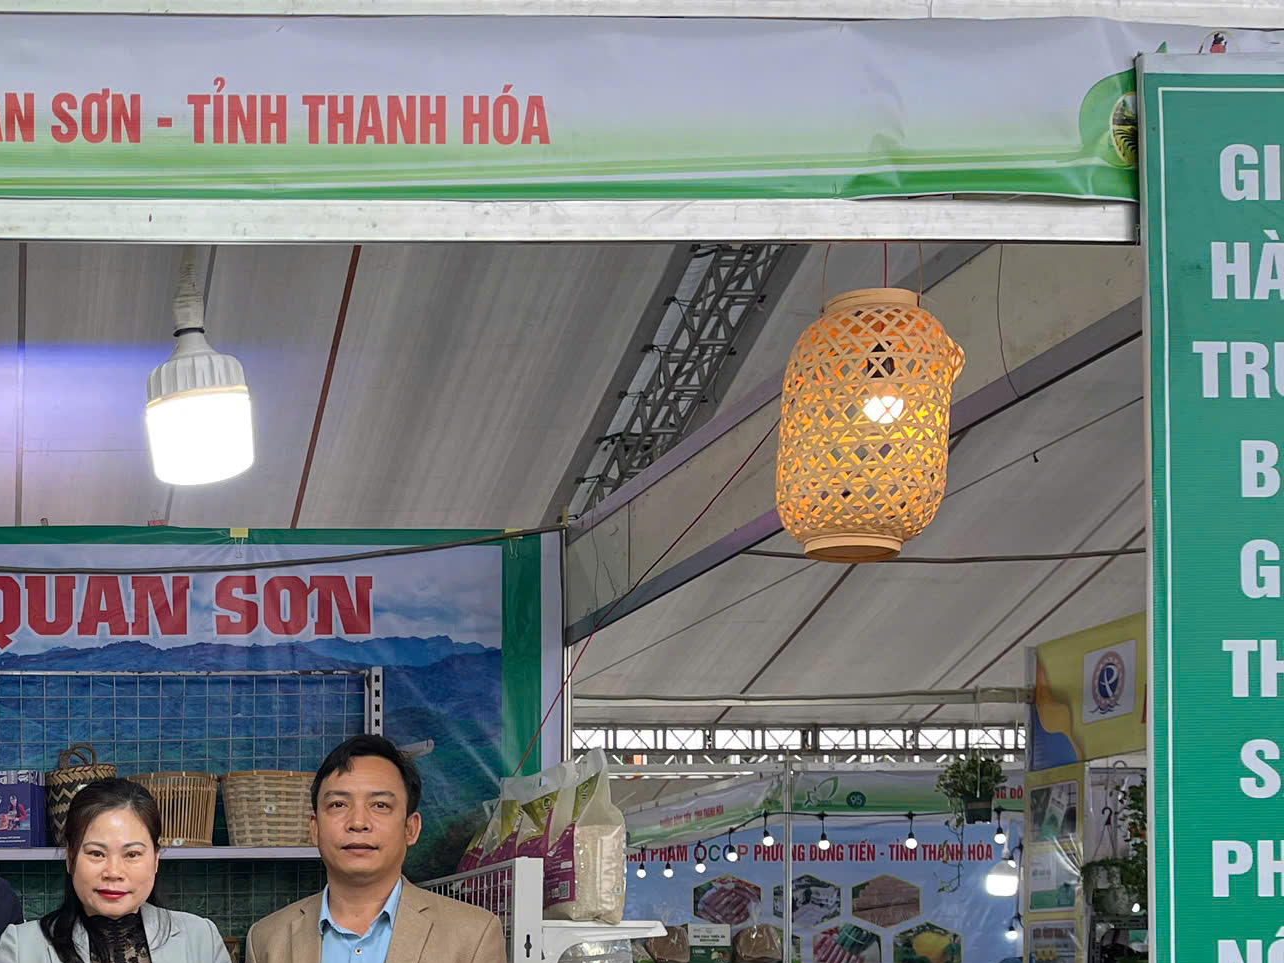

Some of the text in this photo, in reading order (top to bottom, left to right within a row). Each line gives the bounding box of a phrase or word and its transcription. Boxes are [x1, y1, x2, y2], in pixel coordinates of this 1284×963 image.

[51, 88, 142, 144] SƠN
[157, 116, 173, 127] -
[187, 77, 288, 144] TỈNH
[301, 94, 447, 145] THANH
[462, 83, 551, 145] HÓA
[214, 574, 374, 636] SƠN
[848, 838, 876, 862] TIẾN
[922, 843, 963, 862] THANH
[968, 840, 993, 861] HÓA
